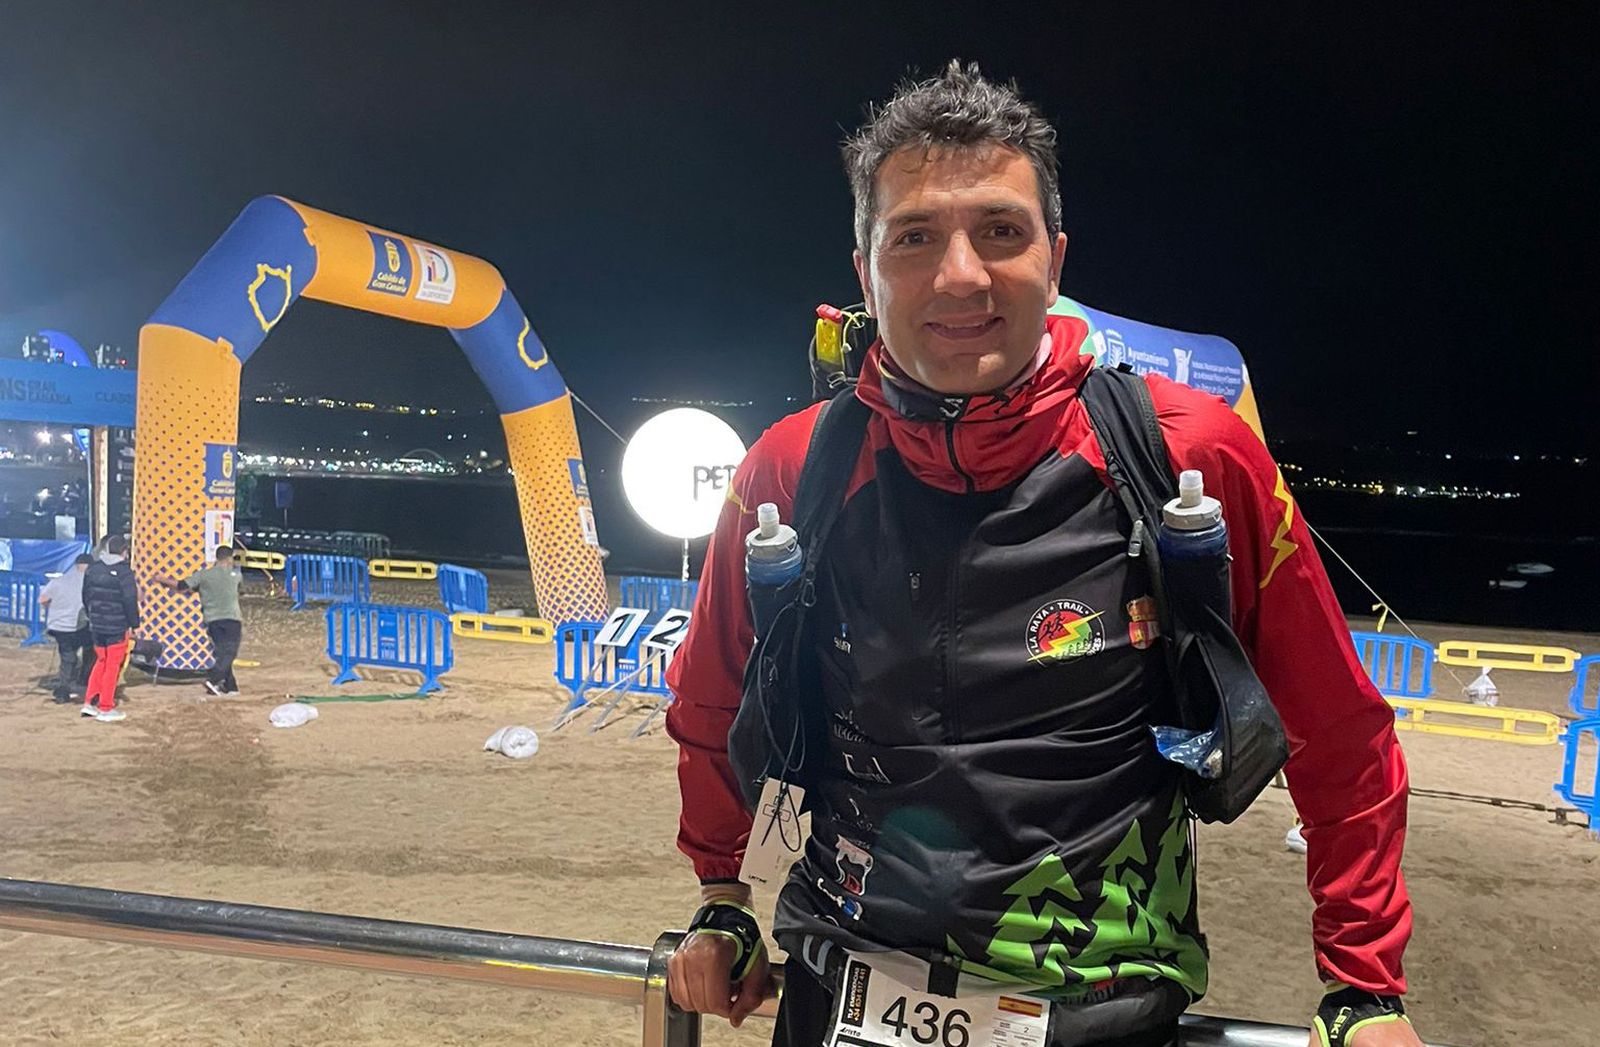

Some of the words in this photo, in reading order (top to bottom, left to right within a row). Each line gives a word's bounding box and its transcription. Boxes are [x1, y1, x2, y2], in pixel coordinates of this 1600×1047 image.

[1128, 347, 1169, 366] Ayuntamiento
[1031, 609, 1049, 632] RAYA
[1057, 602, 1084, 613] TRAIL
[609, 613, 636, 642] 1
[650, 615, 690, 645] 2
[1030, 636, 1039, 649] LA
[881, 996, 971, 1047] 436
[1330, 1006, 1352, 1039] LEKI
